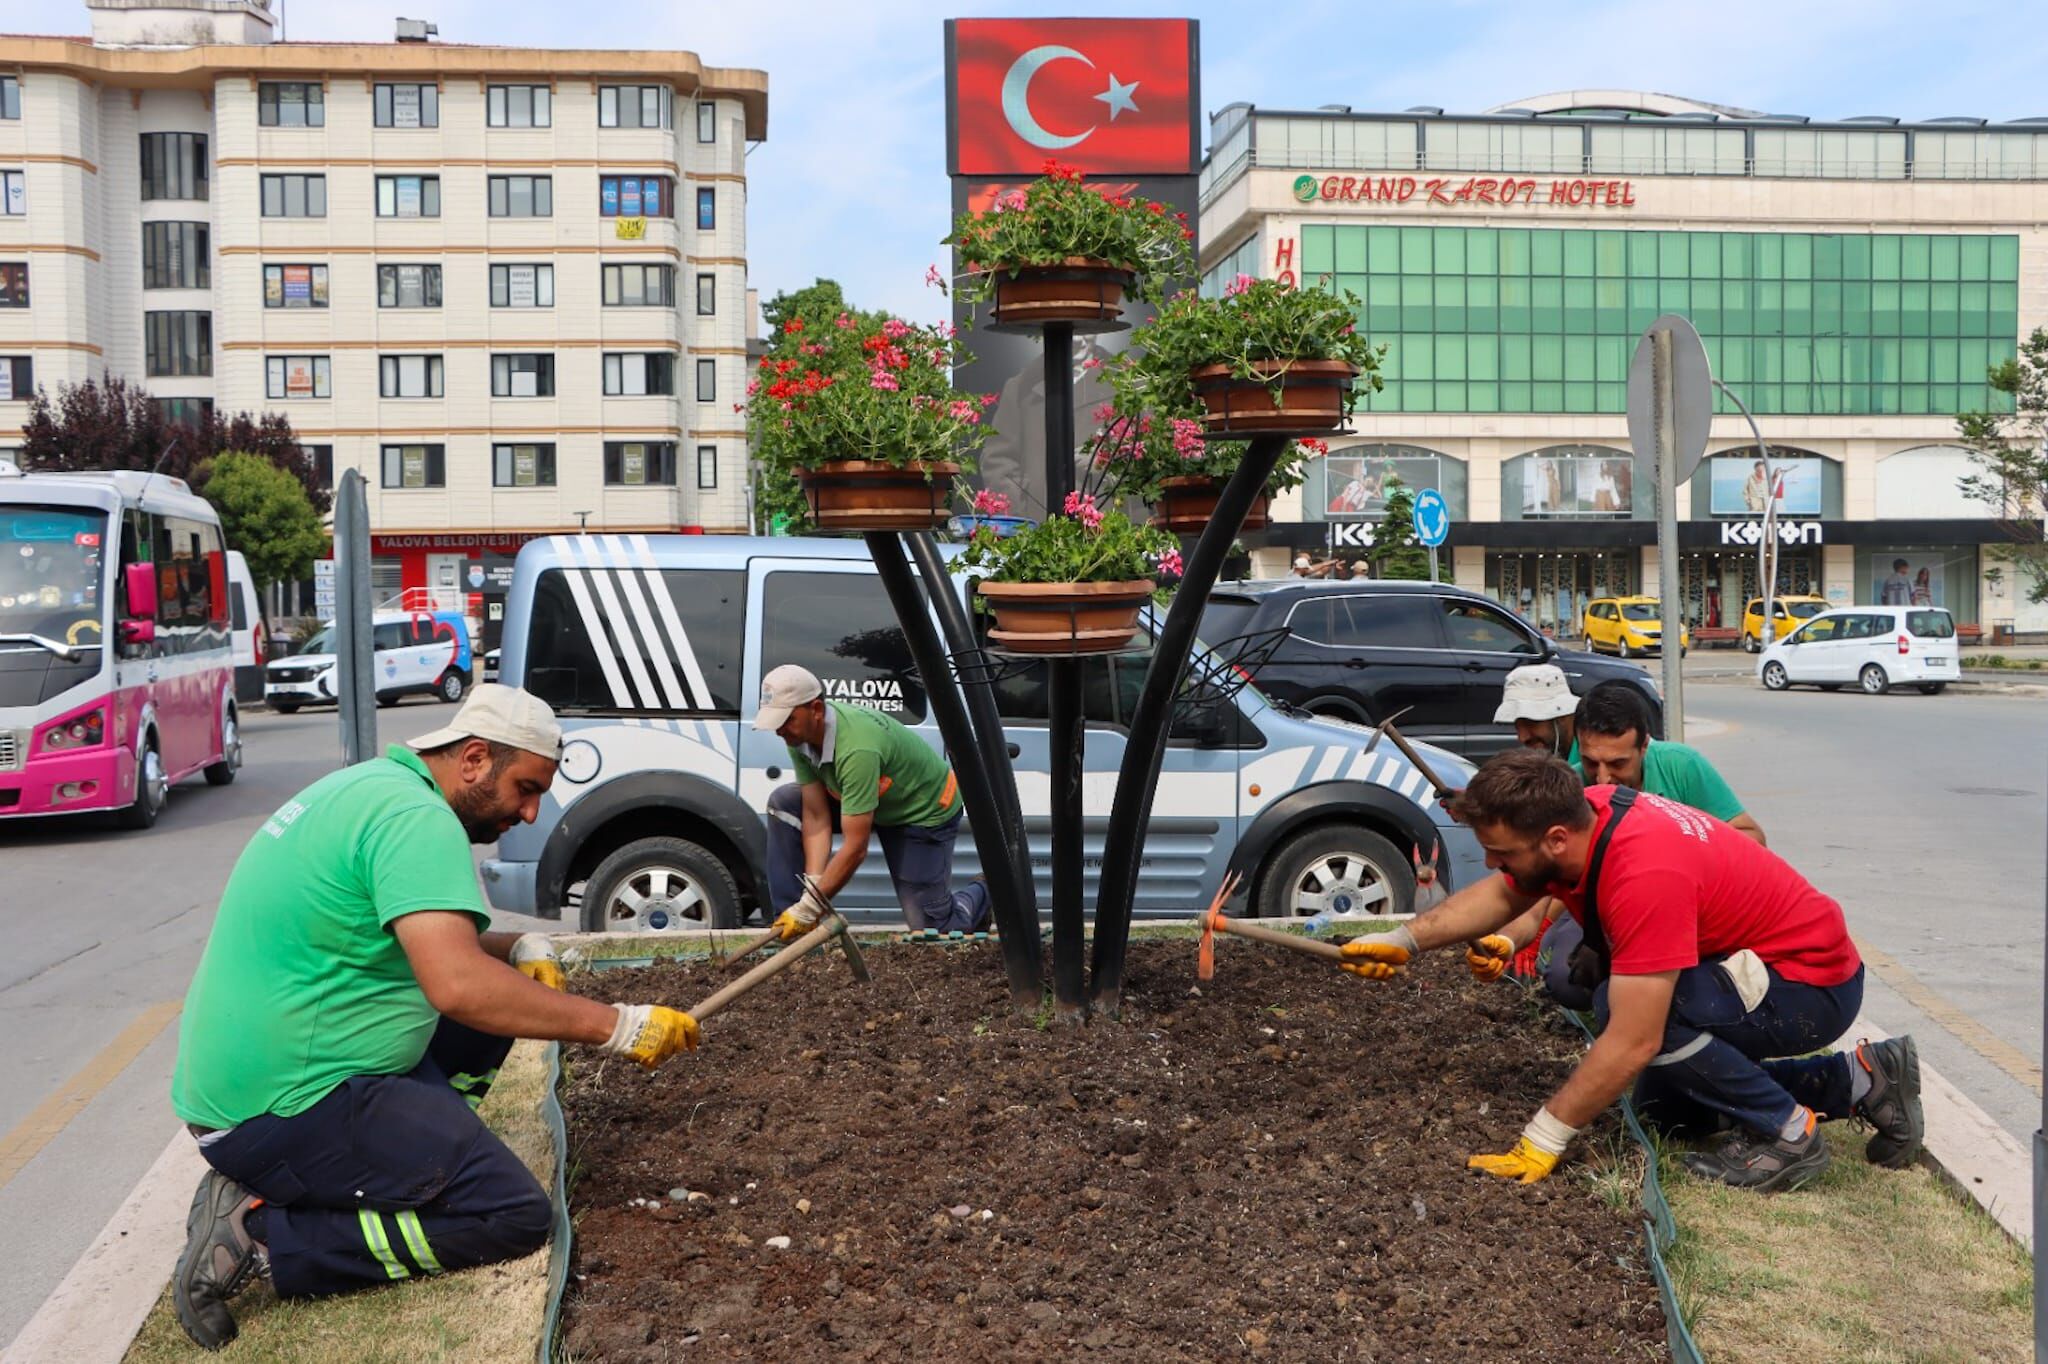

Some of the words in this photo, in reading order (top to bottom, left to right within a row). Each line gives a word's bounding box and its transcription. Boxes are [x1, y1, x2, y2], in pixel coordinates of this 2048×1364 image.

[1321, 176, 1416, 201] GRAND
[1550, 181, 1635, 206] HOTEL
[380, 536, 430, 547] YALOVA
[822, 679, 903, 698] YALOVA
